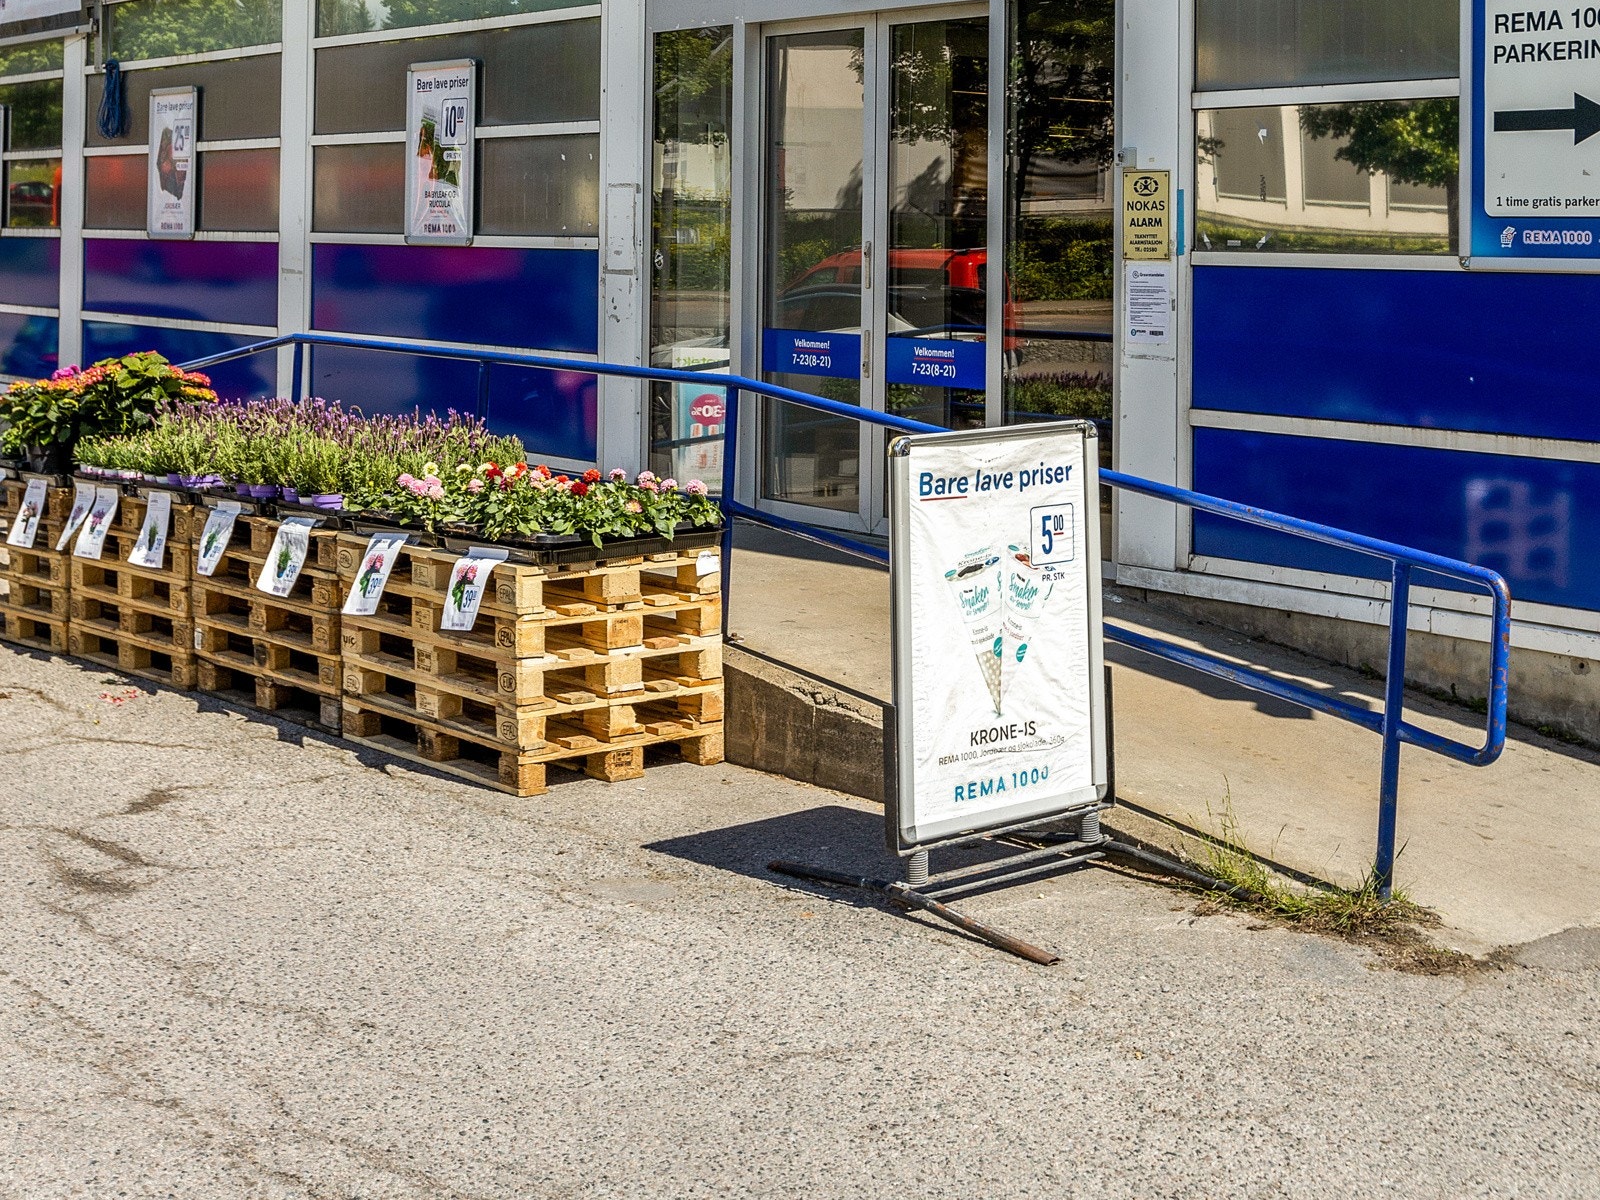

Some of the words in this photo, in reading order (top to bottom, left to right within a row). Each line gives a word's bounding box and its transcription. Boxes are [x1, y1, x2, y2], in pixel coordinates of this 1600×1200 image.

[1494, 10, 1564, 34] REMA
[1571, 7, 1600, 29] 10
[416, 79, 432, 90] Bare
[433, 78, 448, 89] lave
[449, 76, 469, 90] priser
[1126, 200, 1165, 211] NOKAS
[1496, 196, 1502, 206] 1
[1506, 196, 1529, 207] time
[1532, 196, 1561, 209] gratis
[424, 223, 440, 234] REMA
[1129, 217, 1162, 227] ALARM
[1523, 230, 1561, 244] REMA
[1562, 231, 1592, 245] 1000
[794, 338, 830, 349] Velkommen!
[914, 347, 954, 358] Velkommen!
[792, 353, 832, 368] 7-23(8-21)
[912, 363, 956, 378] 7-23(8-21)
[919, 472, 969, 496] Bare
[975, 469, 1013, 492] lave
[1019, 462, 1073, 492] priser
[1041, 515, 1053, 555] 5
[1041, 573, 1053, 583] PR.
[1053, 572, 1066, 581] STK
[970, 720, 1037, 747] KRONE-IS
[938, 755, 960, 766] REMA
[954, 776, 1006, 802] REMA
[1012, 766, 1049, 789] 1000
